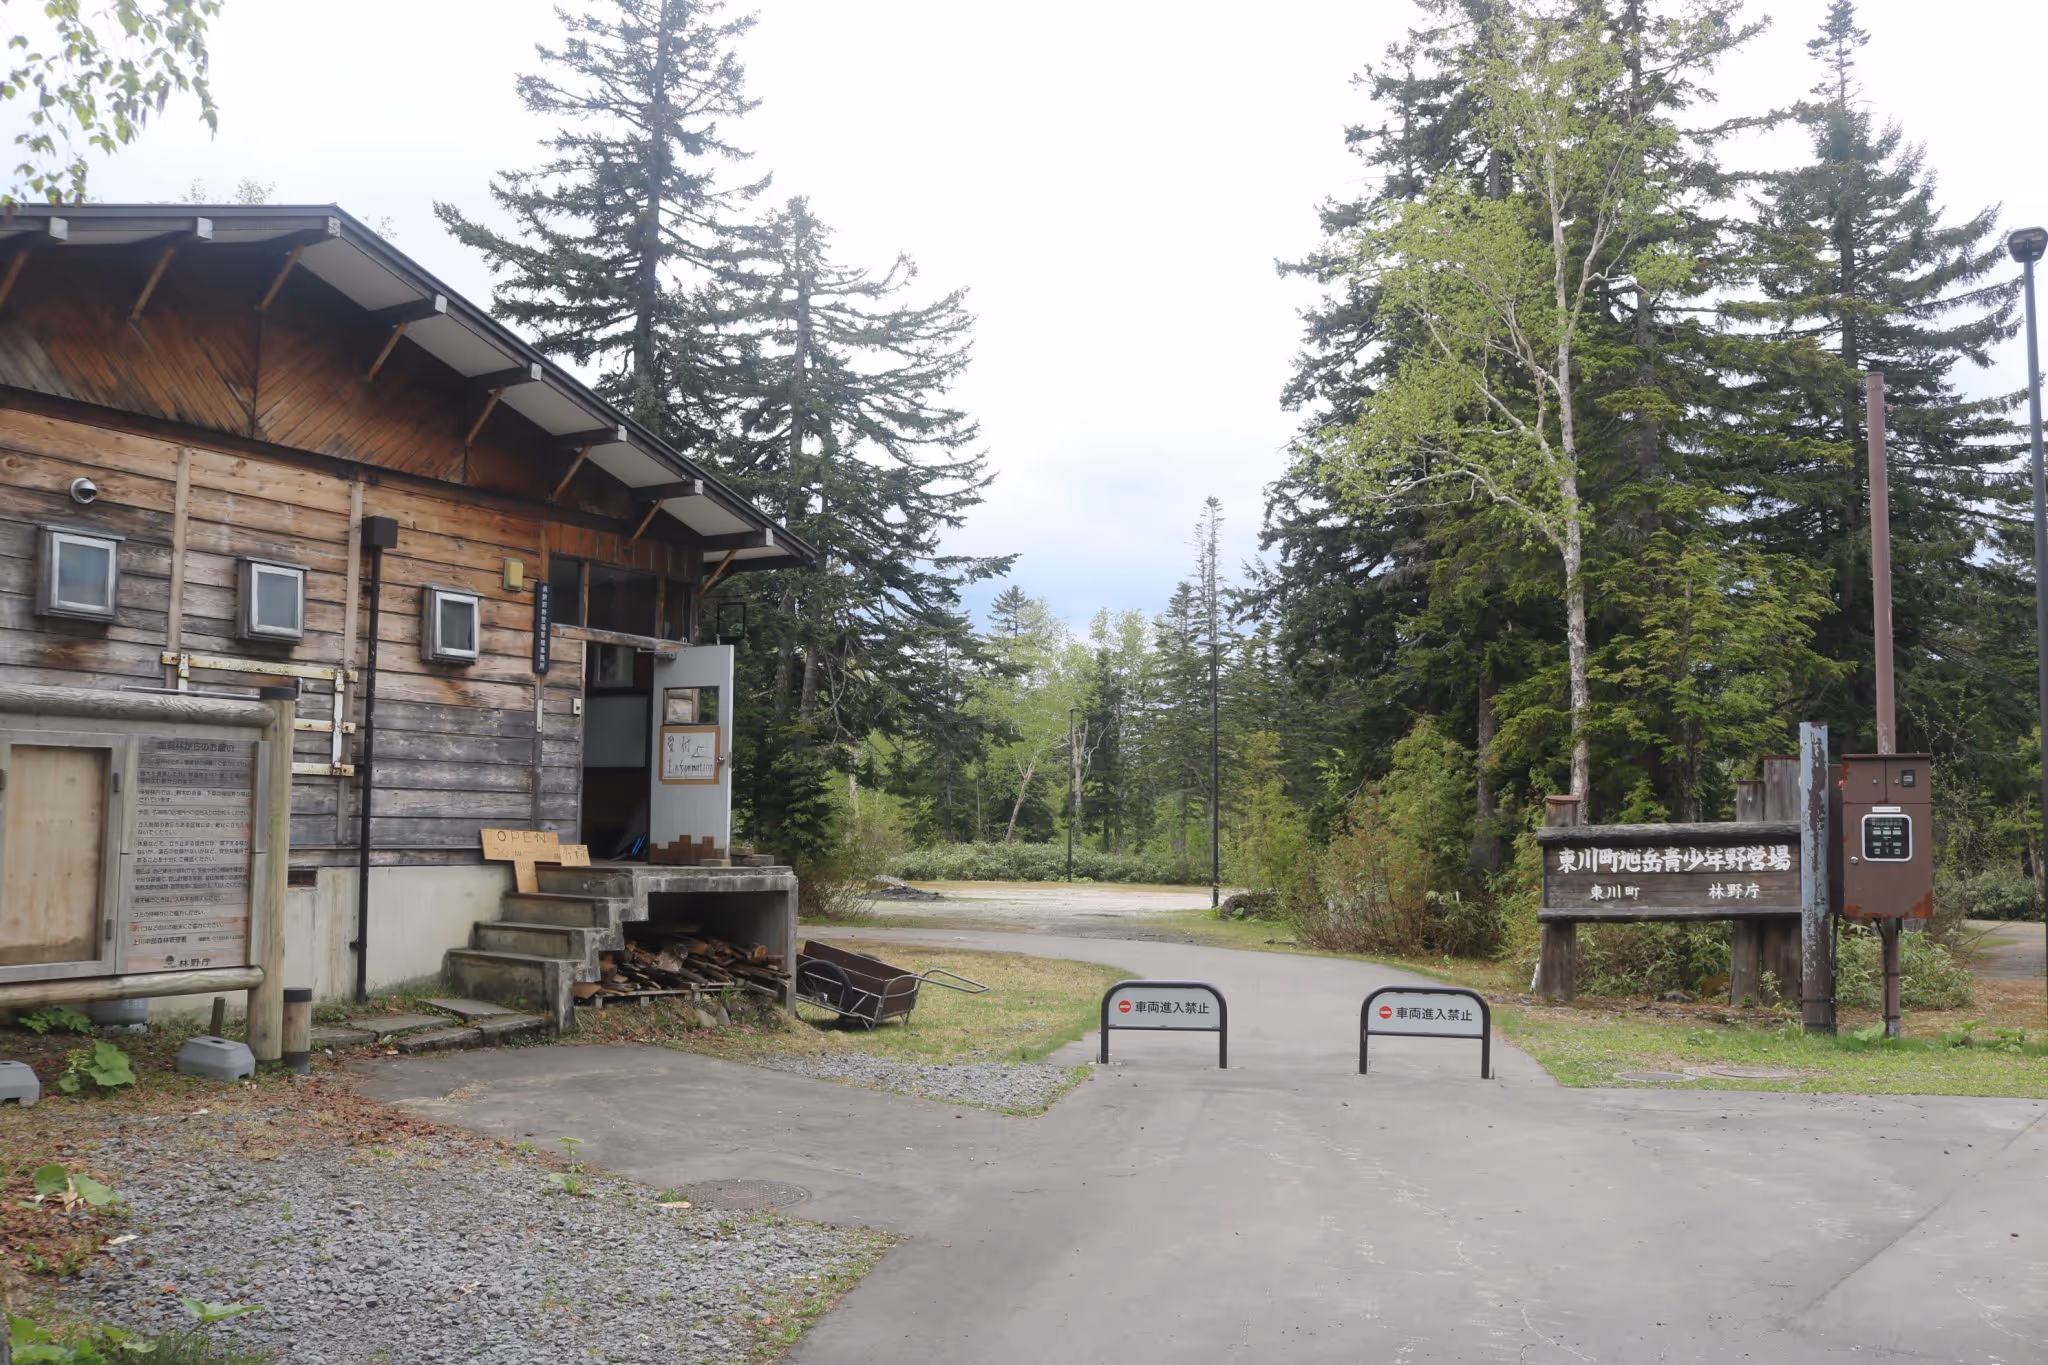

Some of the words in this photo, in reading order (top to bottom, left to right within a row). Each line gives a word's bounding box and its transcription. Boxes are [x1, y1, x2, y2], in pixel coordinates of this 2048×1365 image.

[497, 830, 546, 844] OPEN
[1557, 845, 1792, 873] 東川町旭岳青少年野営場
[1589, 884, 1640, 900] 東川町
[1708, 883, 1761, 899] 林野庁
[178, 958, 212, 968] 林野庁
[1135, 1001, 1210, 1015] 車両進入禁止
[1396, 1007, 1473, 1022] 車両進入禁止
